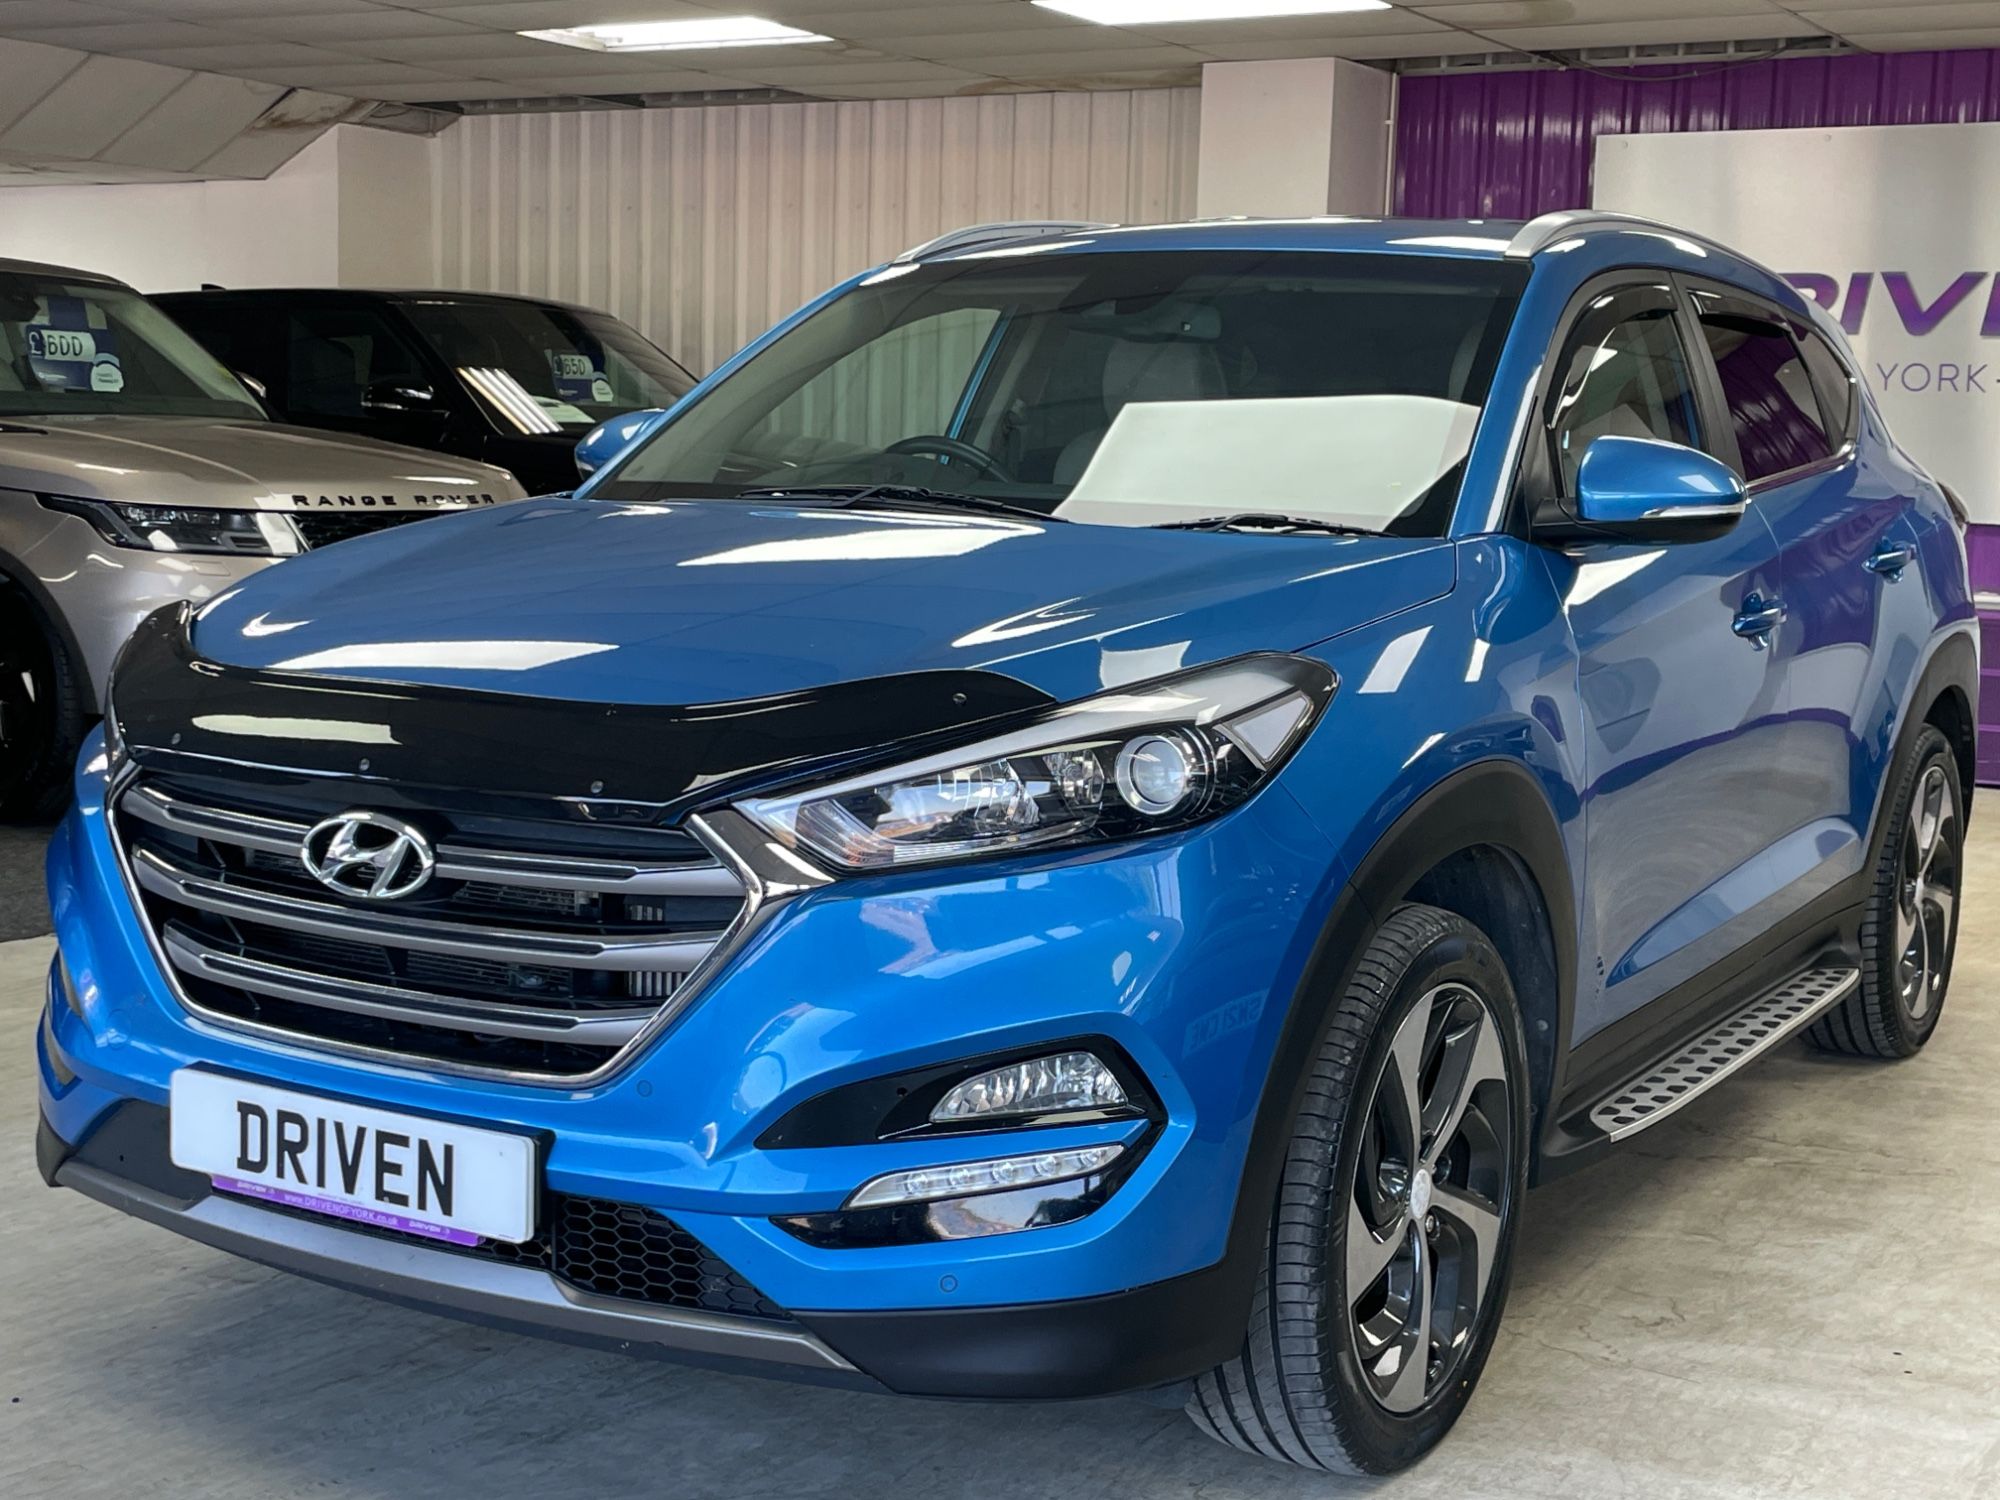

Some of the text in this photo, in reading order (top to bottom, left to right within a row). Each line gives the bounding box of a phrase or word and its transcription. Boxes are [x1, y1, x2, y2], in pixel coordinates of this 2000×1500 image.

[1778, 271, 2000, 336] IV
[1876, 362, 1988, 393] YORK
[291, 493, 495, 507] RANGE ROVER
[236, 1100, 454, 1217] DRIVEN
